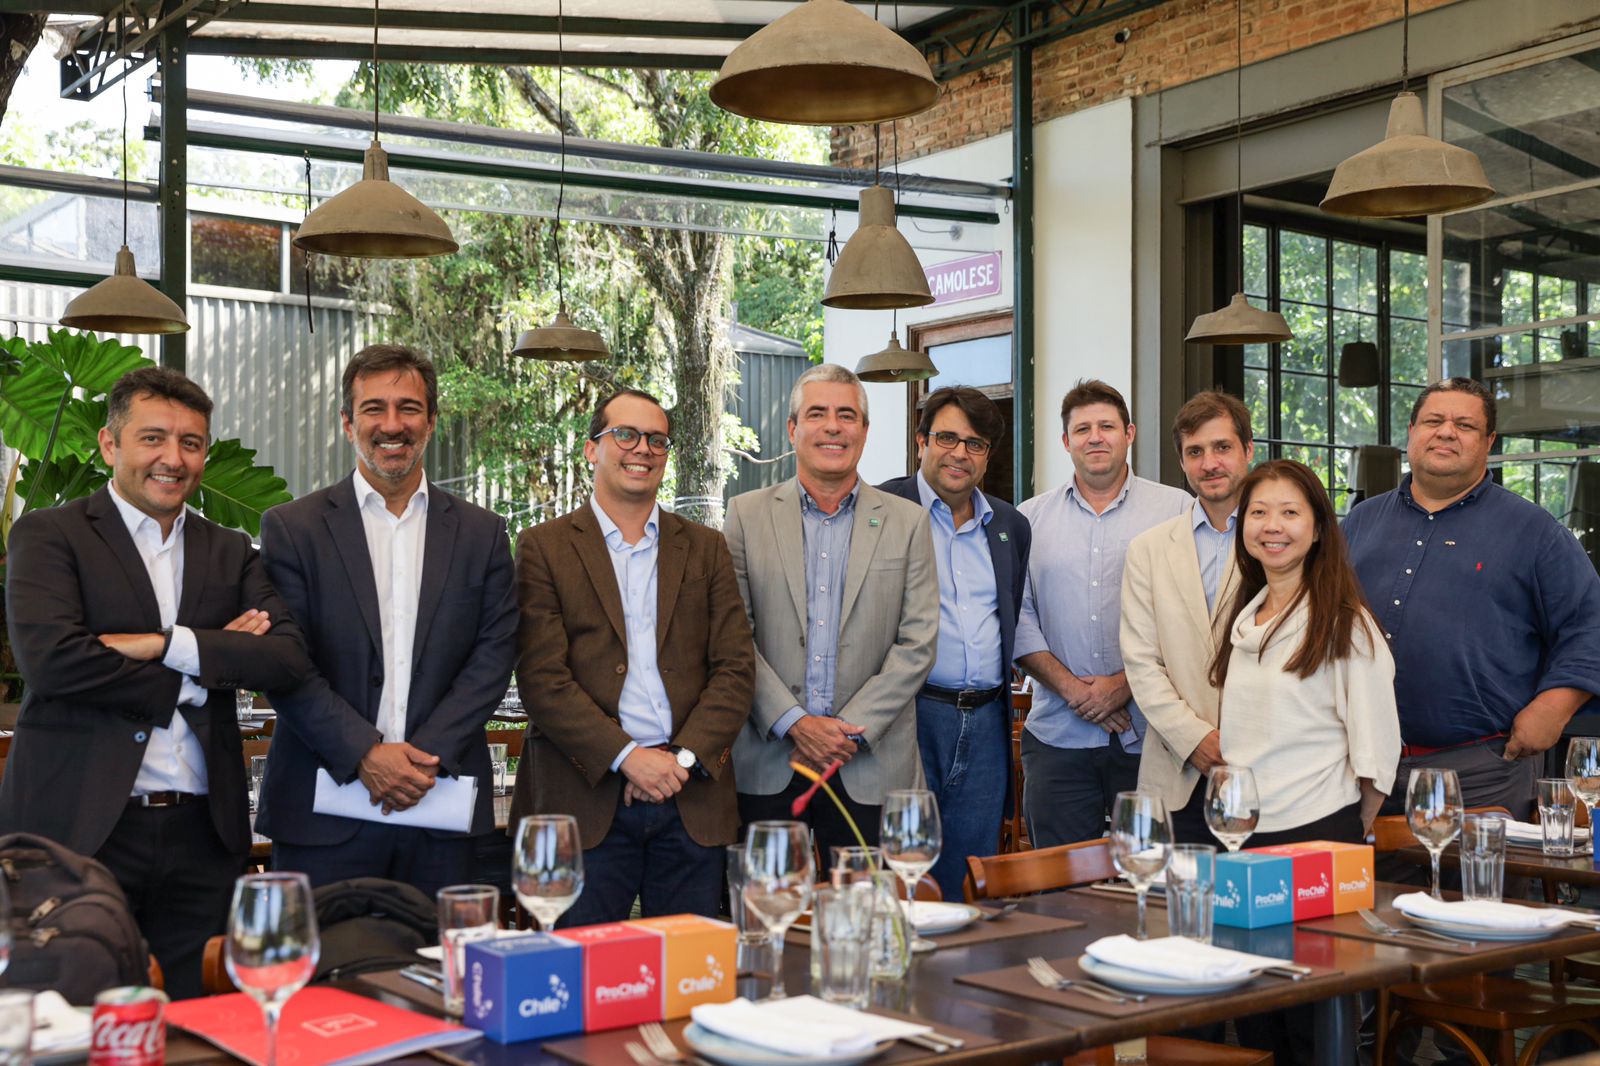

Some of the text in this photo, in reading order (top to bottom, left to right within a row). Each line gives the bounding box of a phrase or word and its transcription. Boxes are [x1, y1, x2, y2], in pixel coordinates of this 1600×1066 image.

[928, 264, 994, 296] CAMOLESE
[1298, 885, 1326, 898] ProChile
[596, 982, 648, 1000] ProChile
[678, 976, 715, 995] Chile
[519, 995, 560, 1017] Chile
